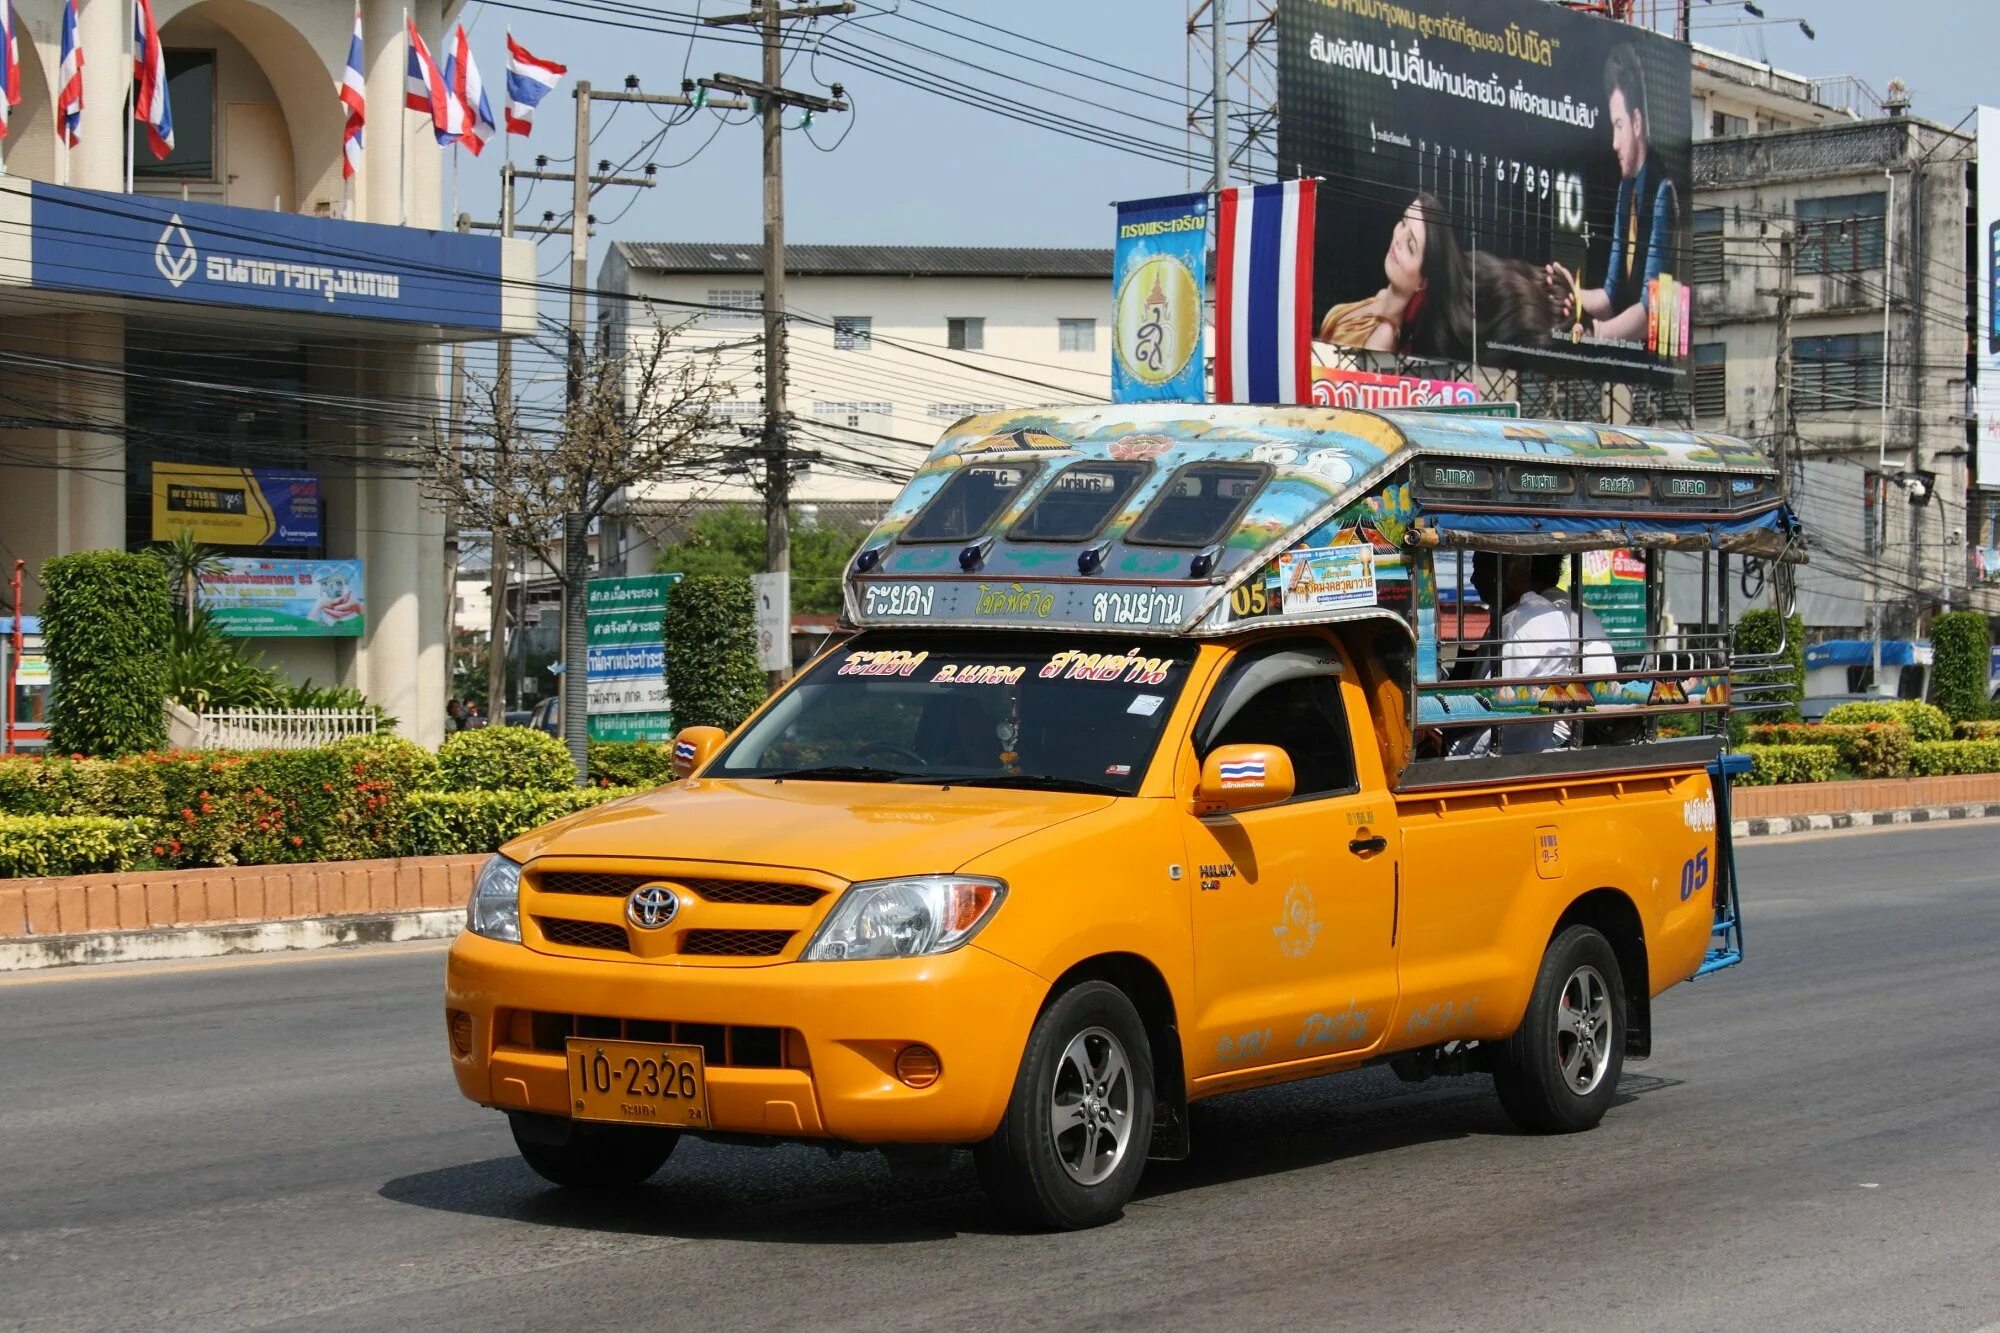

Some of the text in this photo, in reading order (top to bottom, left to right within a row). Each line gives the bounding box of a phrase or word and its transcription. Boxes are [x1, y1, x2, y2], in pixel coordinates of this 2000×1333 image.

[1497, 159, 1505, 181] 6
[1512, 162, 1520, 183] 7
[1526, 166, 1535, 193] 8
[1539, 169, 1549, 199] 9
[1555, 171, 1584, 229] 10
[1120, 215, 1206, 239] ทรงพระเจริญ
[206, 256, 399, 302] ธนาคารกรุงเทพ
[1435, 468, 1475, 486] อ.แกลง
[171, 489, 216, 500] WESTERN
[185, 499, 217, 508] UNION
[866, 585, 935, 616] ระยอง
[1093, 586, 1184, 624] สามย่าน
[1230, 581, 1266, 616] 05
[594, 620, 662, 635] ศาลจังหวัดระยอ
[838, 647, 1174, 686] ระยอง อ.แกลง สามย่าน
[1199, 863, 1237, 879] HILUX
[1680, 847, 1709, 902] 05
[580, 1054, 697, 1100] 10-2326
[621, 1102, 657, 1117] ระยอง
